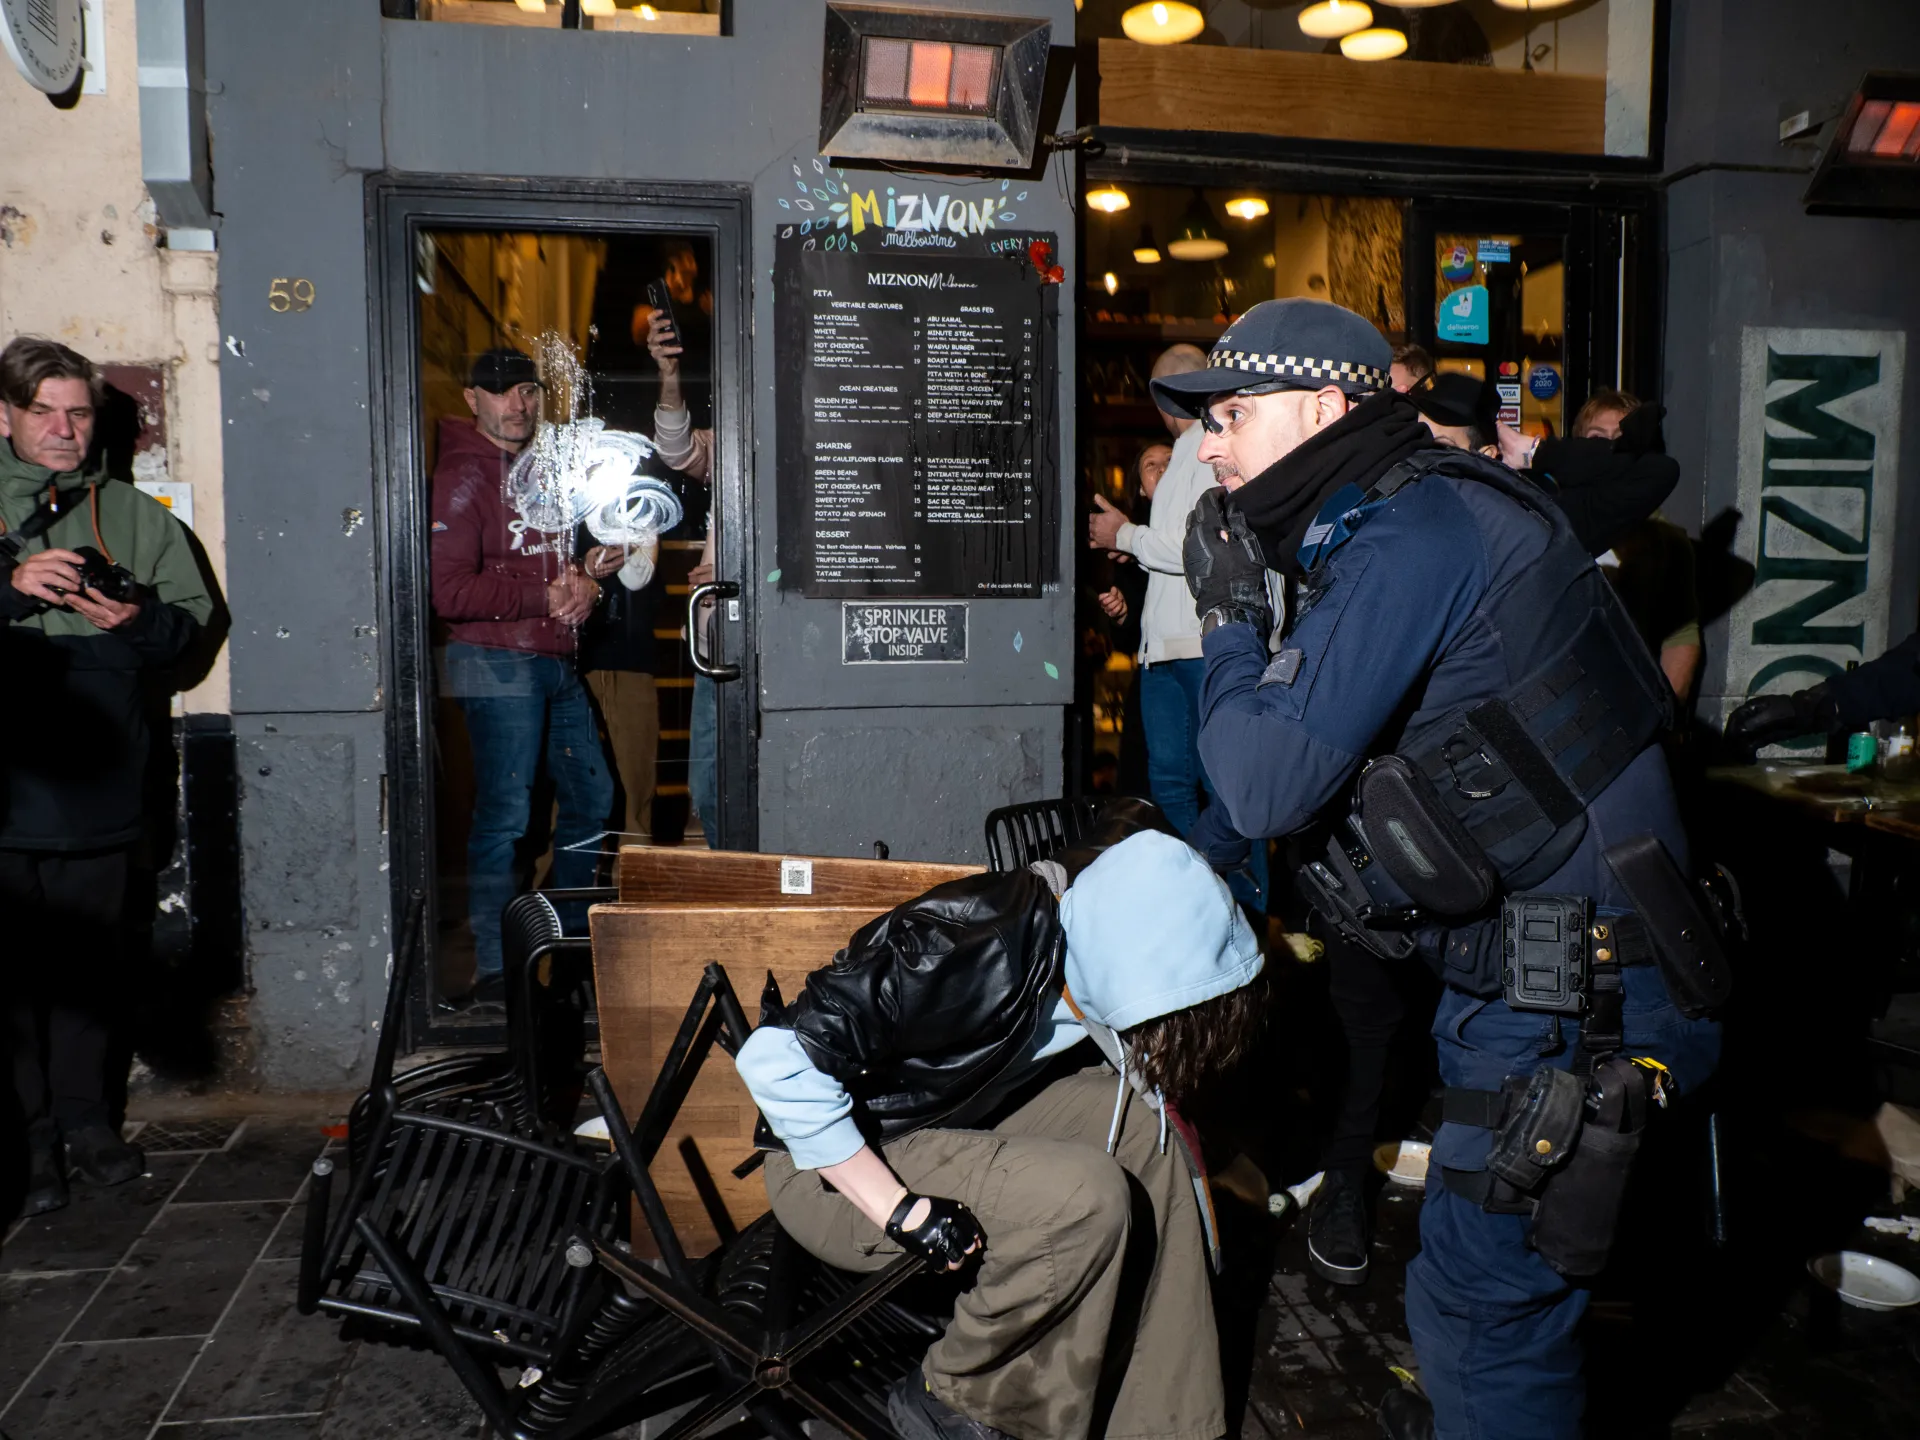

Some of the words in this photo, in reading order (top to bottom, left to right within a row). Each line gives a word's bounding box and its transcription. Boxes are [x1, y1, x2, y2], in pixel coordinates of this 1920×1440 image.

[882, 230, 956, 247] melbourne
[991, 238, 1022, 253] EVERY
[868, 272, 929, 287] MIZNON
[268, 278, 316, 313] 59
[813, 289, 833, 298] PITA
[864, 608, 947, 626] SPRINKLER
[863, 627, 900, 644] STOP
[905, 627, 948, 644] VALVE
[888, 644, 923, 657] INSIDE
